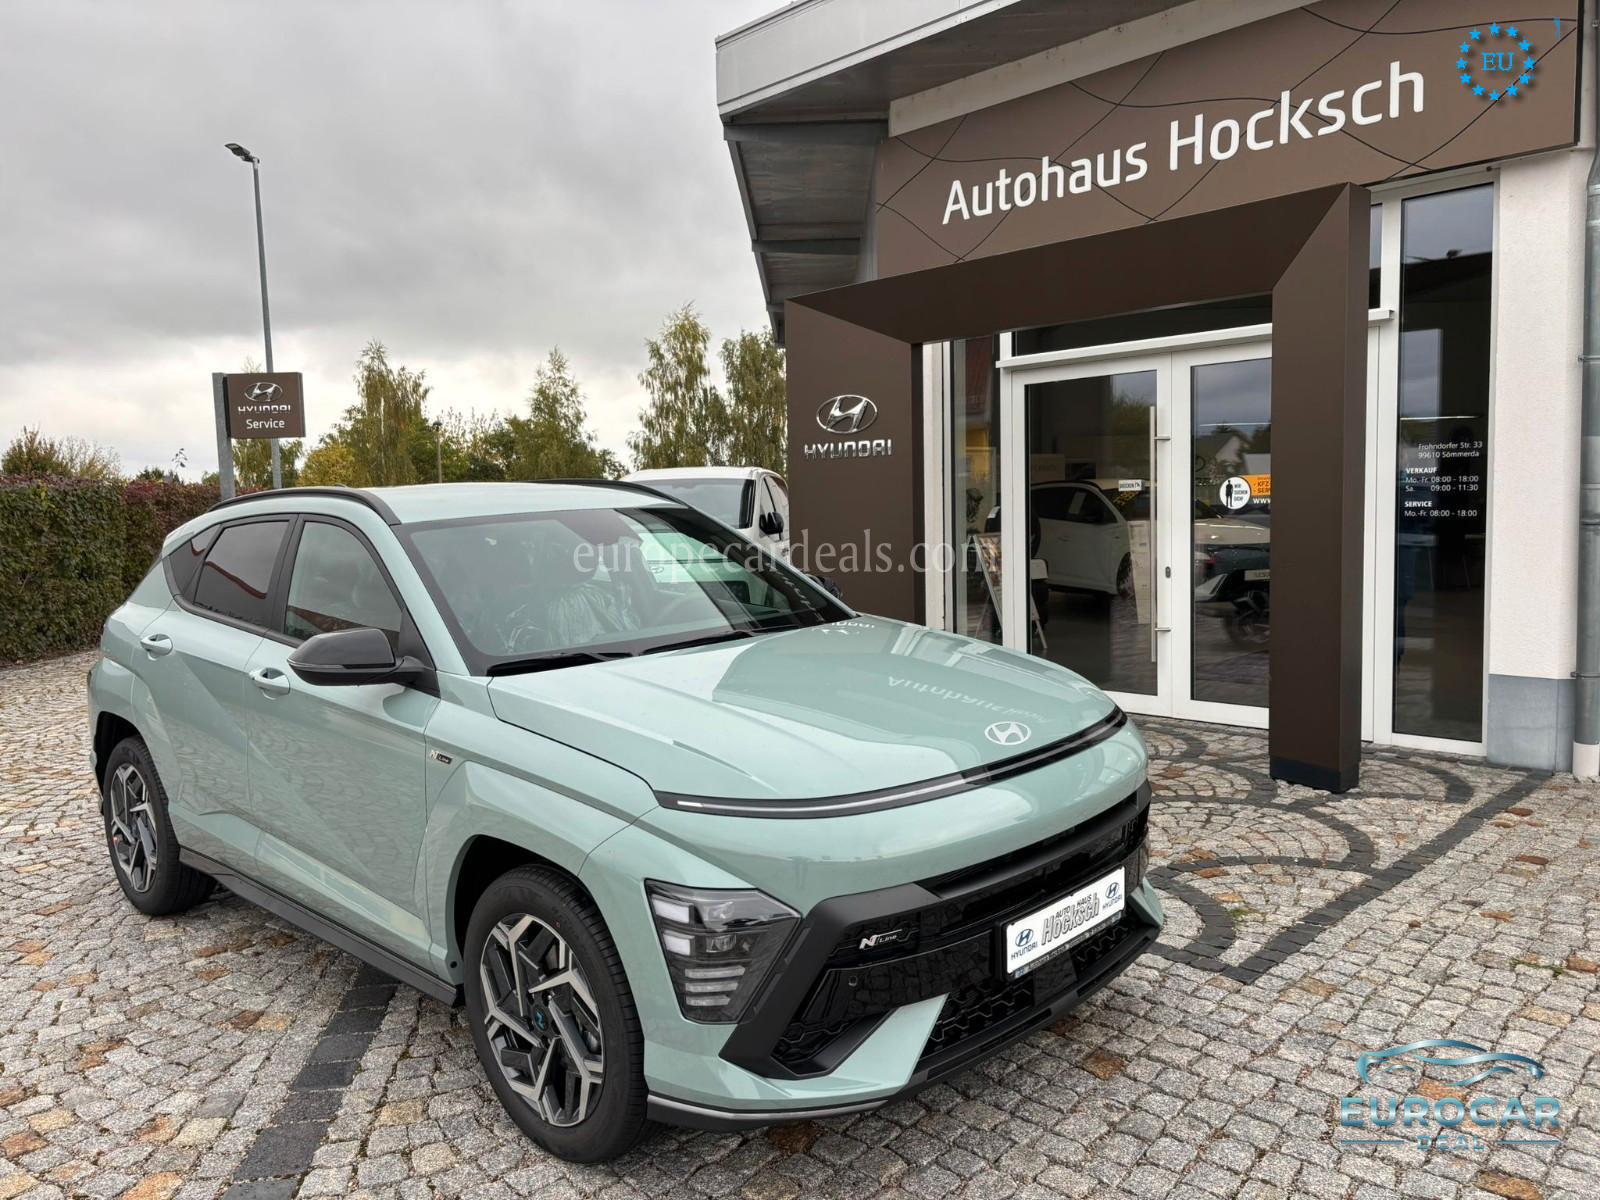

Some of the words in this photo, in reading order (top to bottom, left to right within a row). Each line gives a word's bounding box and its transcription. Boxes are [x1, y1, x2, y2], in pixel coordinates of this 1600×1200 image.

[942, 142, 1148, 225] Autohaus
[1168, 60, 1424, 172] Hocksch
[246, 418, 285, 429] Service
[804, 439, 892, 458] HYUNDAI
[1418, 442, 1458, 450] Frohndorfer
[1460, 441, 1471, 449] Str.
[1418, 451, 1440, 459] 99610
[1457, 509, 1477, 517] 18:00
[1010, 941, 1038, 960] HYUNDAI
